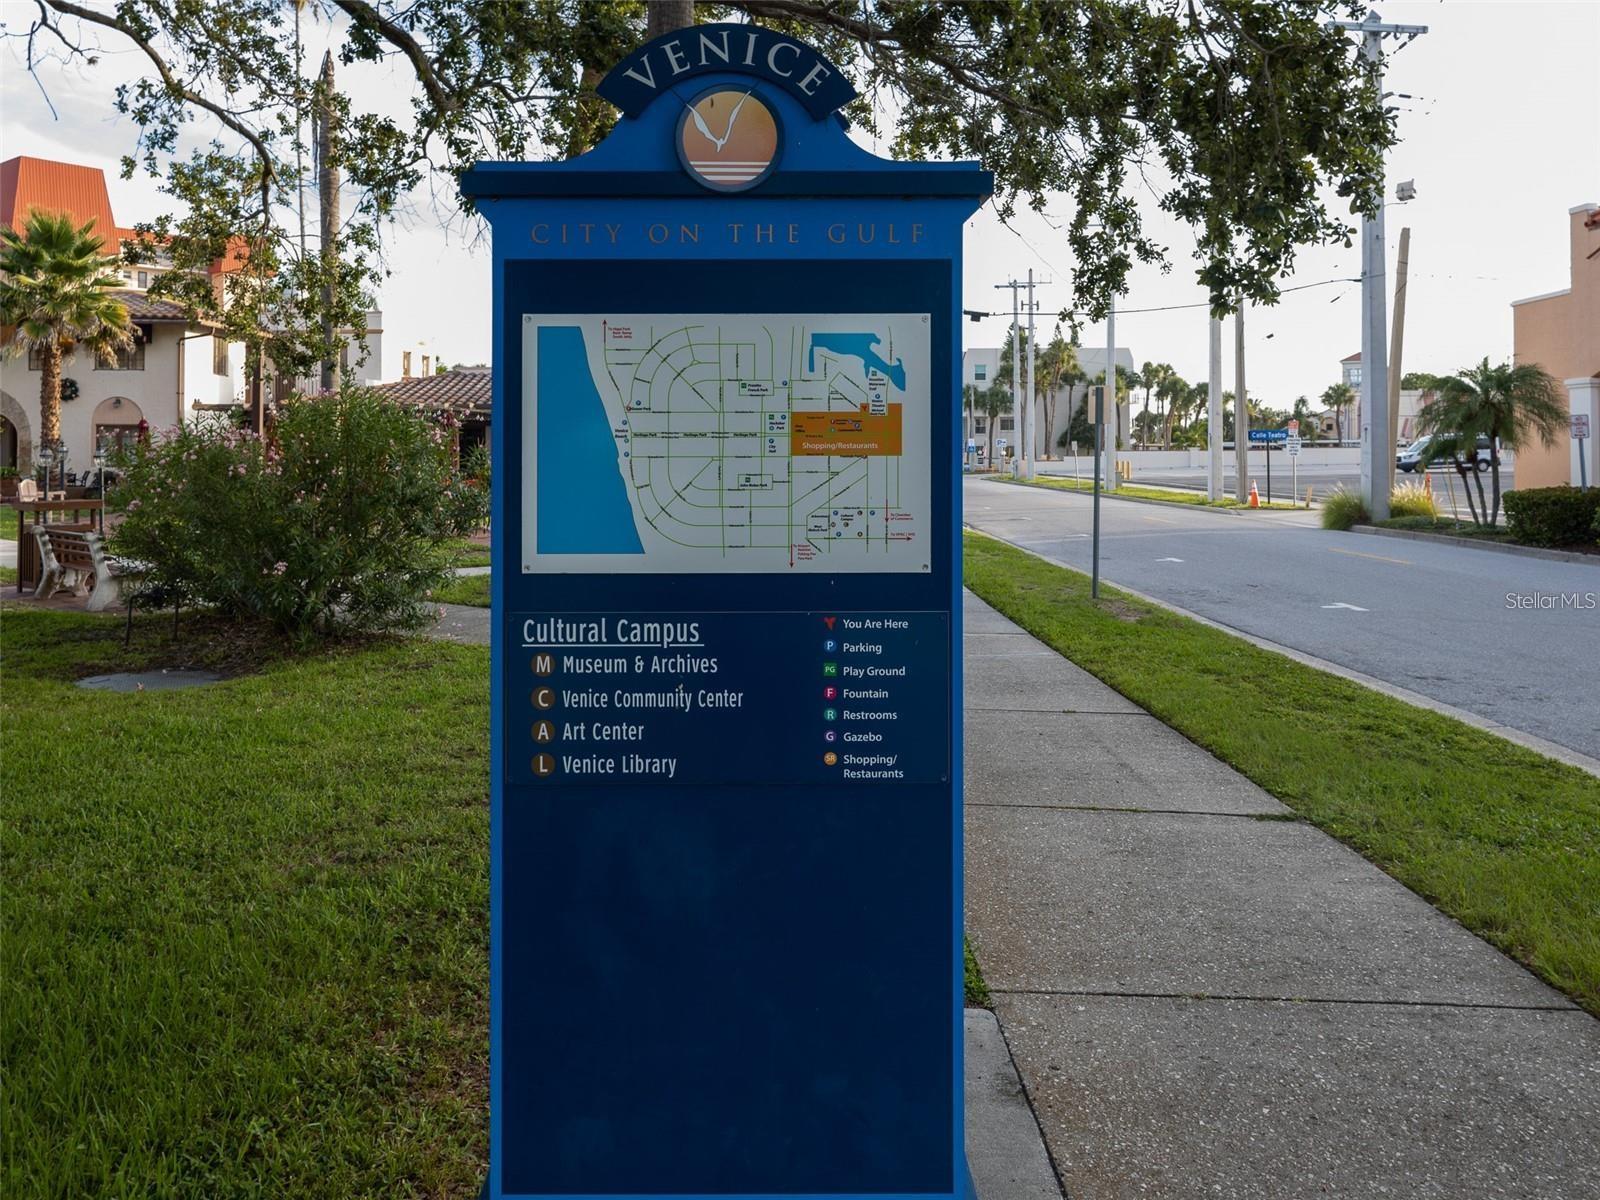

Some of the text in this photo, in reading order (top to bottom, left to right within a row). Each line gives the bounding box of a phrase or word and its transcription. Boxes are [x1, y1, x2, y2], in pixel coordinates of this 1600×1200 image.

[622, 30, 831, 96] VENICE
[530, 223, 927, 245] CITY ON THE GULF
[802, 441, 878, 450] Shopping/Restaurants
[843, 619, 909, 629] You Are Here
[523, 617, 700, 648] Cultural Campus
[843, 643, 882, 655] Parking
[536, 653, 718, 673] M Museum & Archives
[843, 666, 865, 678] Play
[866, 666, 906, 677] Ground
[843, 688, 889, 699] Fountain
[538, 688, 743, 712] C Venice Community Center
[843, 710, 897, 720] Restrooms
[537, 722, 645, 741] A Art Center
[825, 732, 883, 743] G Gazebo
[539, 754, 677, 778] L Venice Library
[843, 754, 898, 766] Shopping/
[843, 768, 904, 779] Restaurants
